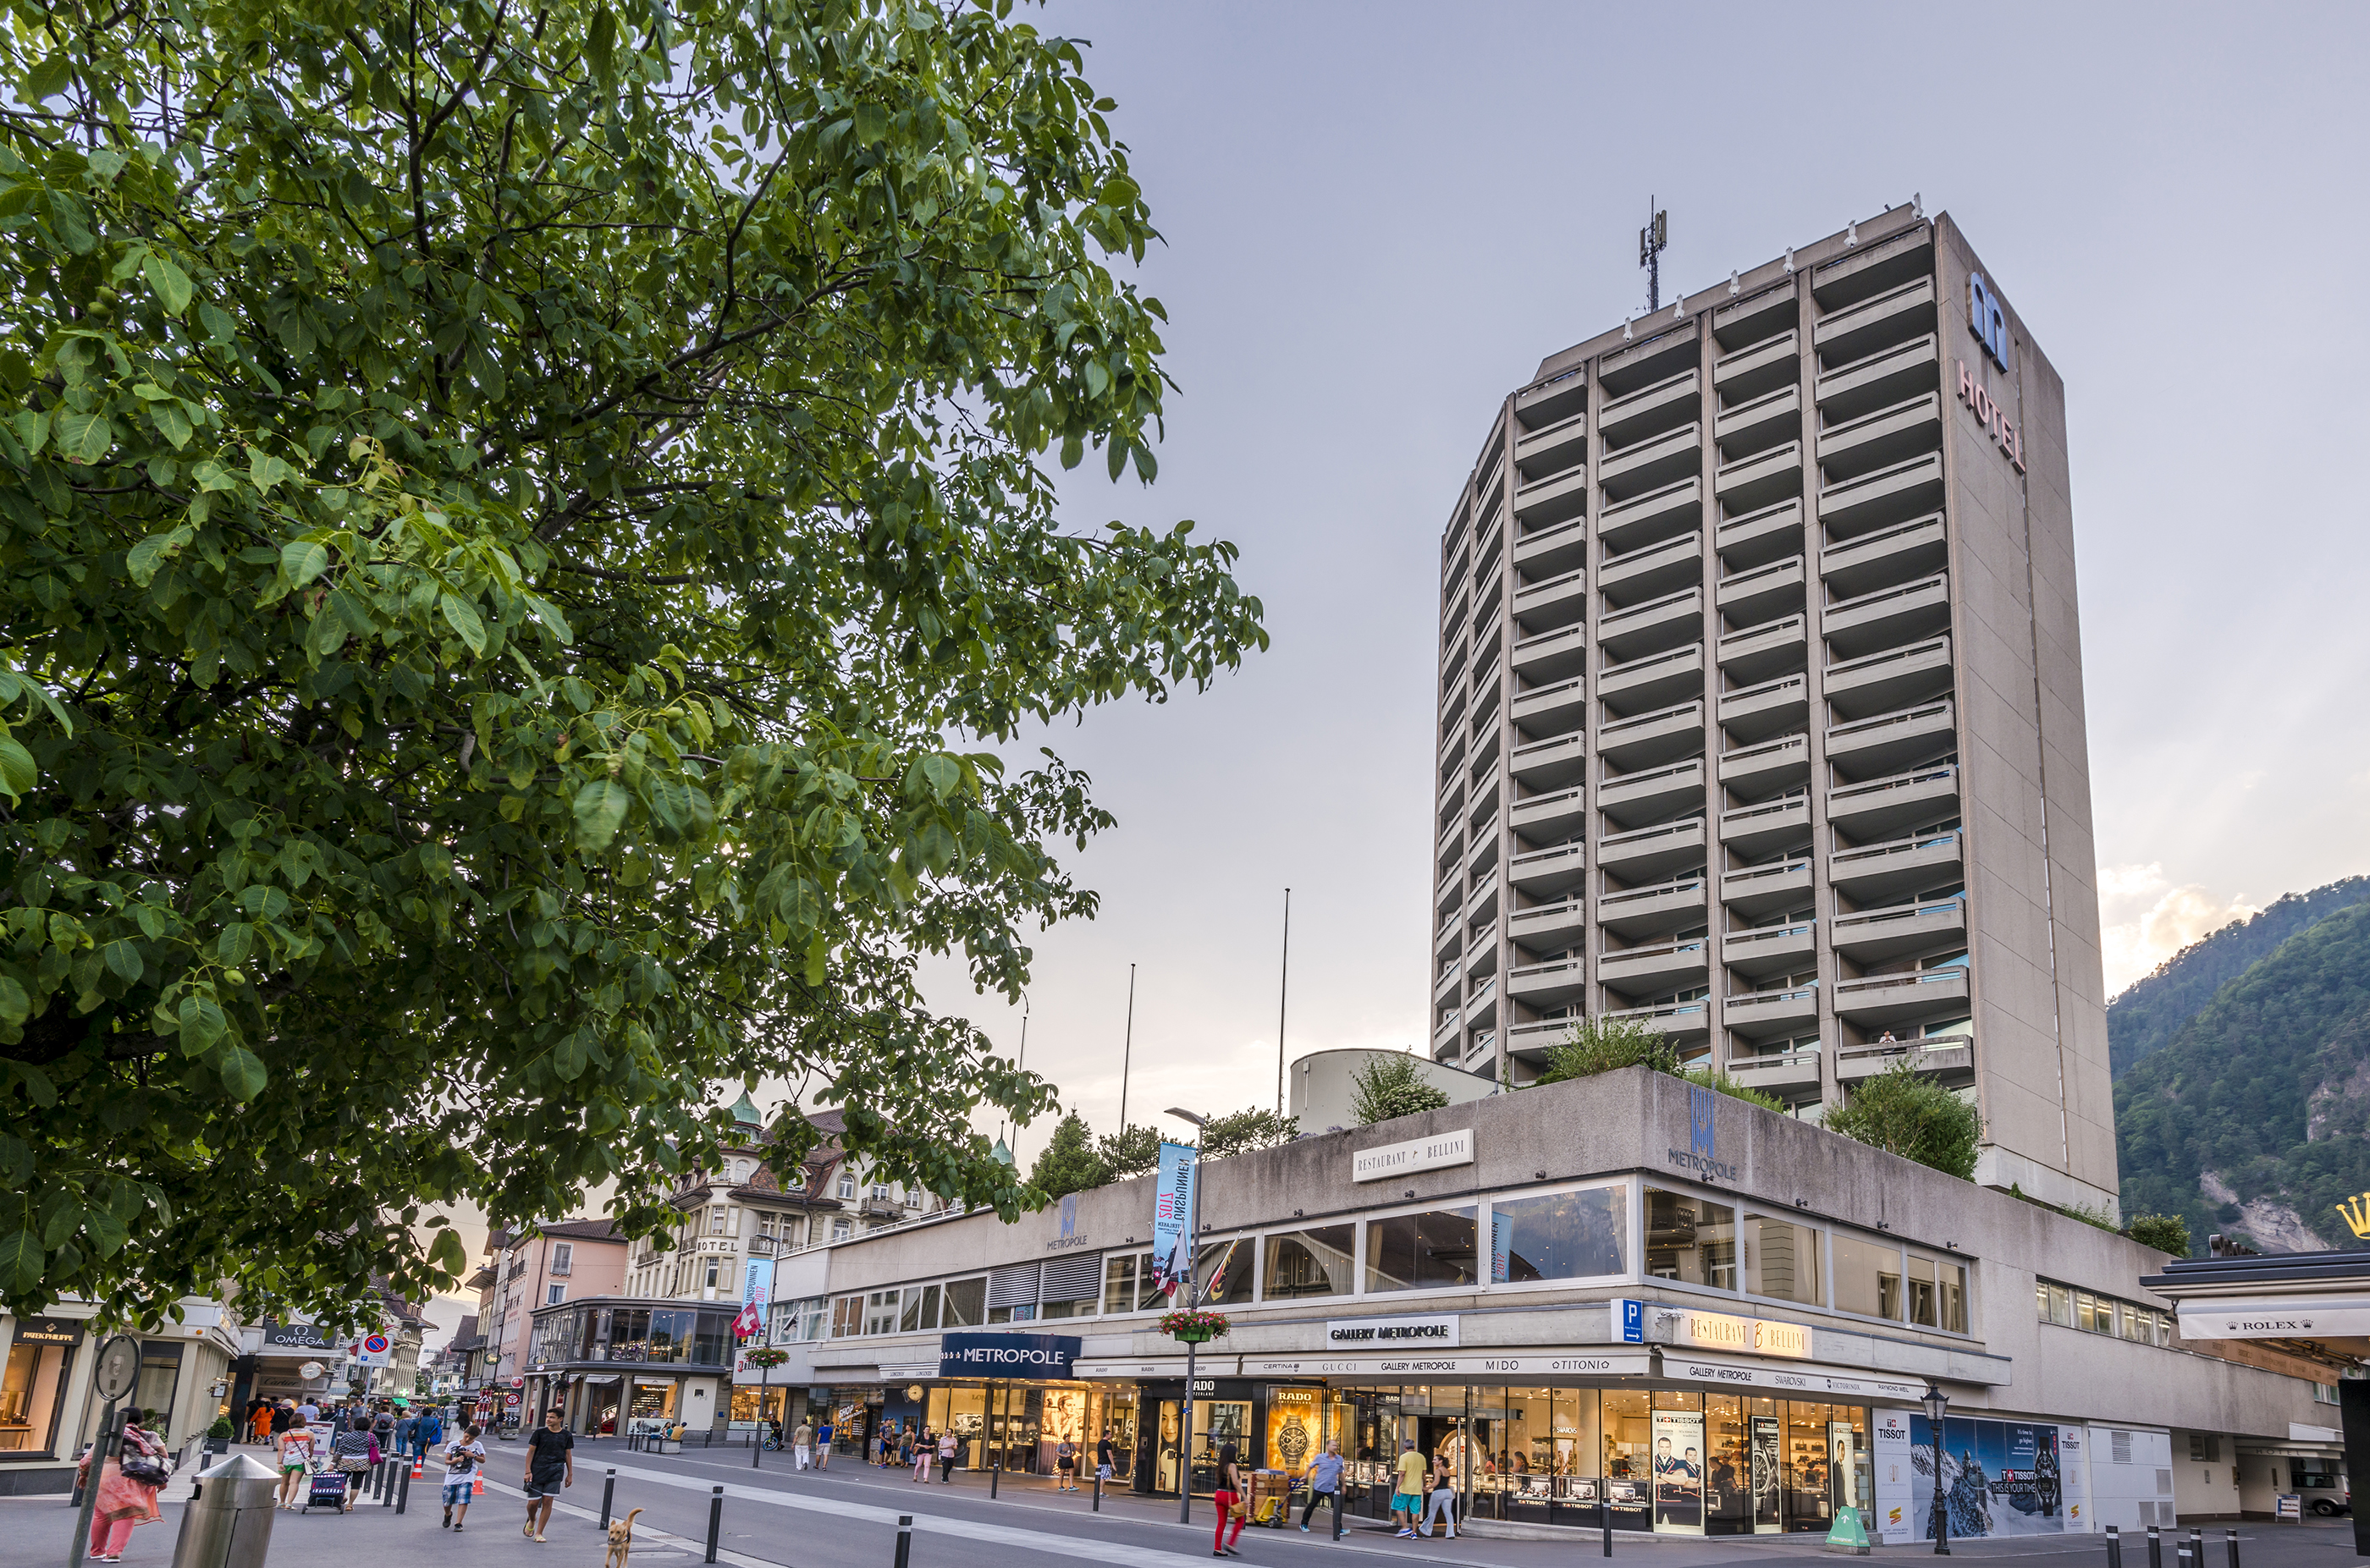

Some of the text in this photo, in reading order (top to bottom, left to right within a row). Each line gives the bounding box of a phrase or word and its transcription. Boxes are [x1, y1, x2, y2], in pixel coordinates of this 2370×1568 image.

[1957, 359, 2026, 474] HOTEL
[1358, 1151, 1406, 1172] RESTAURANT
[1427, 1140, 1464, 1158] BELLINI
[1667, 1147, 1737, 1181] METROPOLE
[1046, 1235, 1089, 1251] METROPOLE
[1496, 1252, 1505, 1276] 2017
[746, 1265, 758, 1301] UNSPUNNEN
[754, 1286, 766, 1302] 2017
[1629, 1304, 1637, 1323] P
[2243, 1321, 2298, 1330] ROLEX
[23, 1331, 74, 1342] PATEK PHILIPPE
[1331, 1324, 1449, 1340] GALLERY METROPOLE
[1690, 1318, 1747, 1343] RESTAURANT
[1771, 1329, 1805, 1350] BELLINI
[275, 1334, 326, 1345] OMEGA
[963, 1348, 1064, 1365] METROPOLE
[1322, 1362, 1357, 1371] GUCCI
[1381, 1362, 1456, 1371] GALLERY METROPOLE
[1485, 1361, 1519, 1371] MIDO
[1561, 1360, 1600, 1370] TITONI
[1689, 1366, 1752, 1381] GALLERY METROPOLE
[263, 1377, 299, 1386] Cartier
[1775, 1375, 1806, 1387] SWAROVSKI
[1832, 1381, 1861, 1390] VICTORINOX
[1877, 1384, 1899, 1392] RAYMOND
[1278, 1392, 1312, 1401] RADO
[839, 1405, 854, 1418] SHOP
[1878, 1428, 1905, 1439] TISSOT
[2062, 1441, 2080, 1450] TISSOT
[2014, 1472, 2035, 1481] TISSOT
[1992, 1483, 2003, 1493] THIS
[2009, 1483, 2024, 1493] YOUR
[2024, 1483, 2036, 1494] TIME
